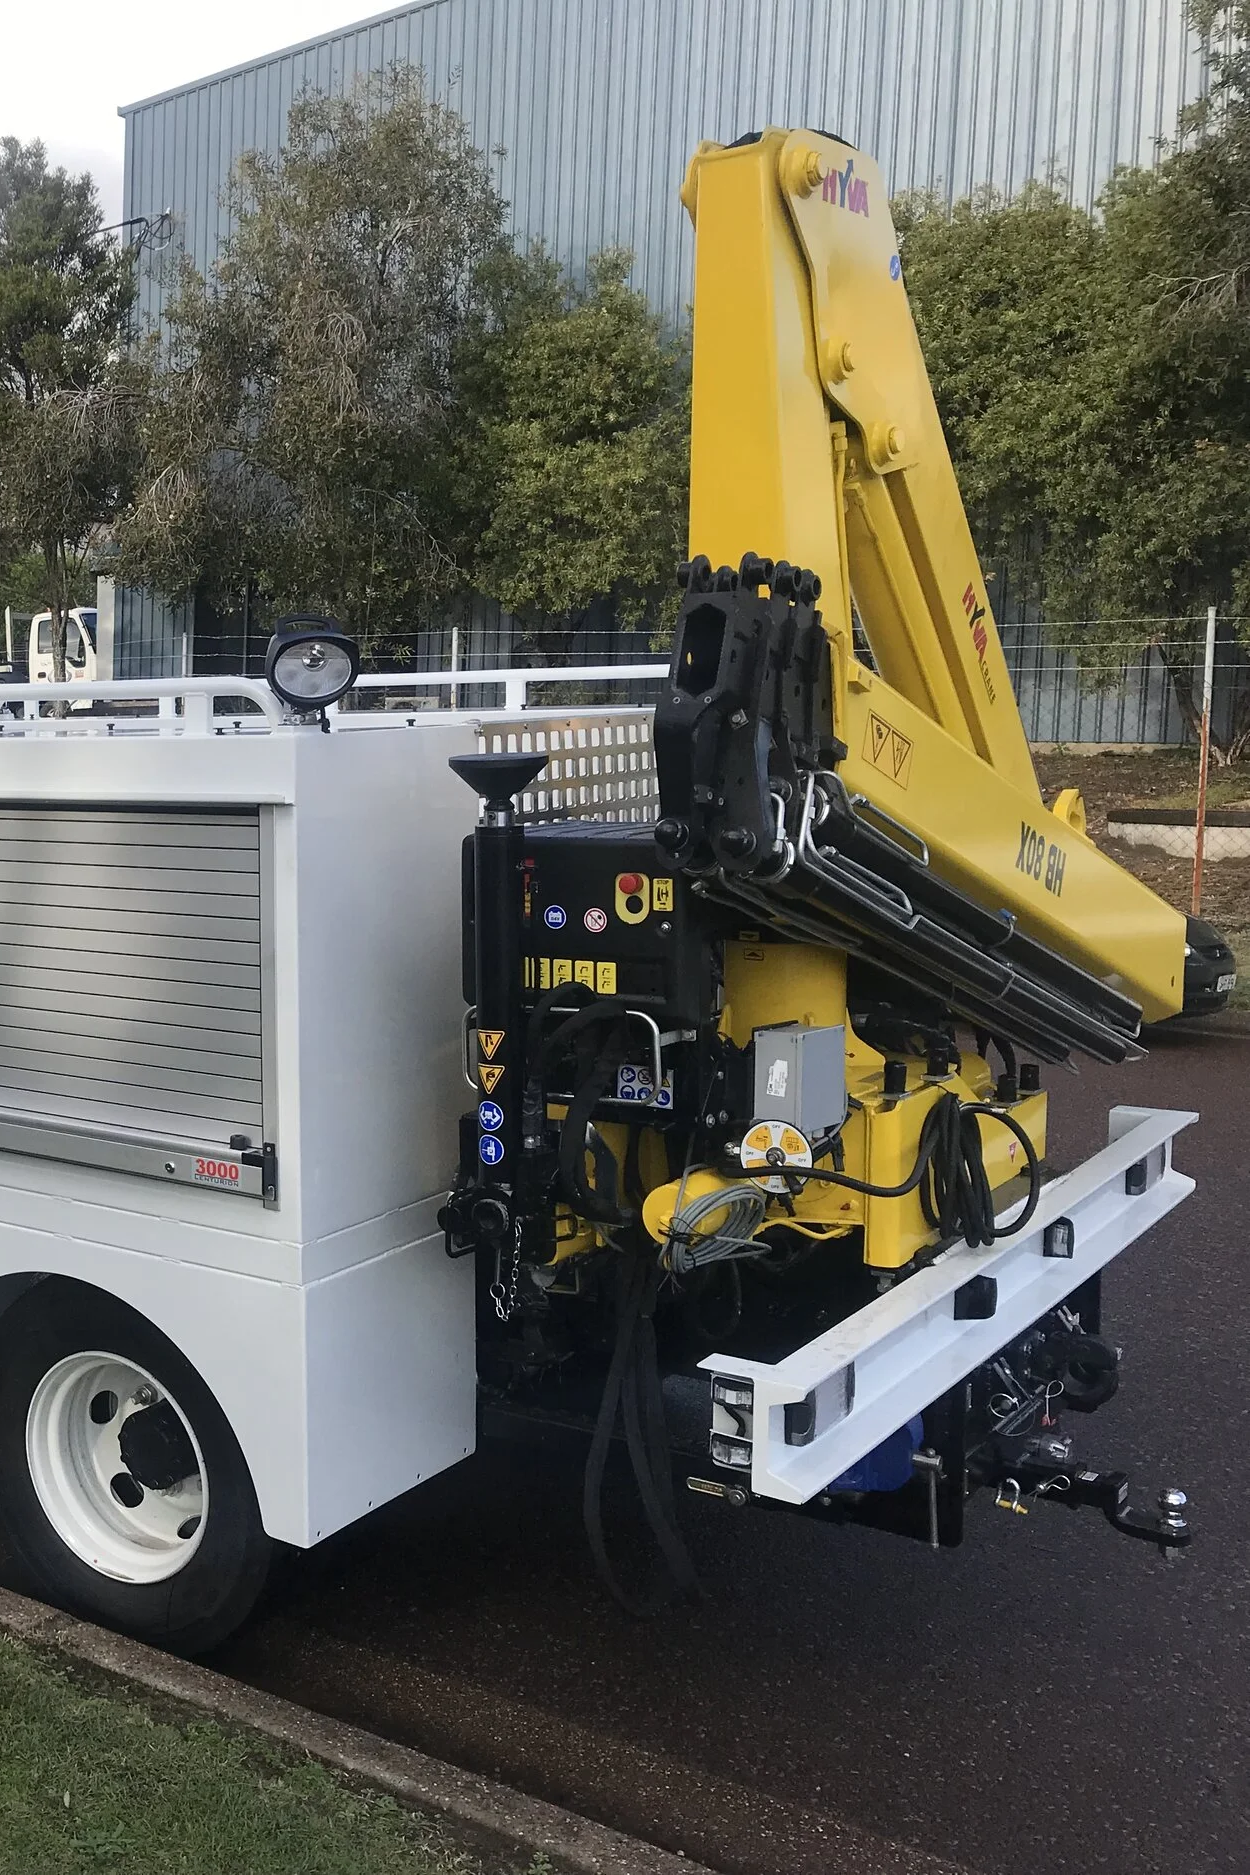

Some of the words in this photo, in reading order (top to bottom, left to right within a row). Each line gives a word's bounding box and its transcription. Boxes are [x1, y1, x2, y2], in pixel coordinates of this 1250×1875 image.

[822, 159, 869, 218] HYVA
[962, 581, 987, 663] HYVA
[1015, 820, 1045, 881] 80X
[1045, 844, 1066, 898] HB
[195, 1158, 239, 1180] 3000
